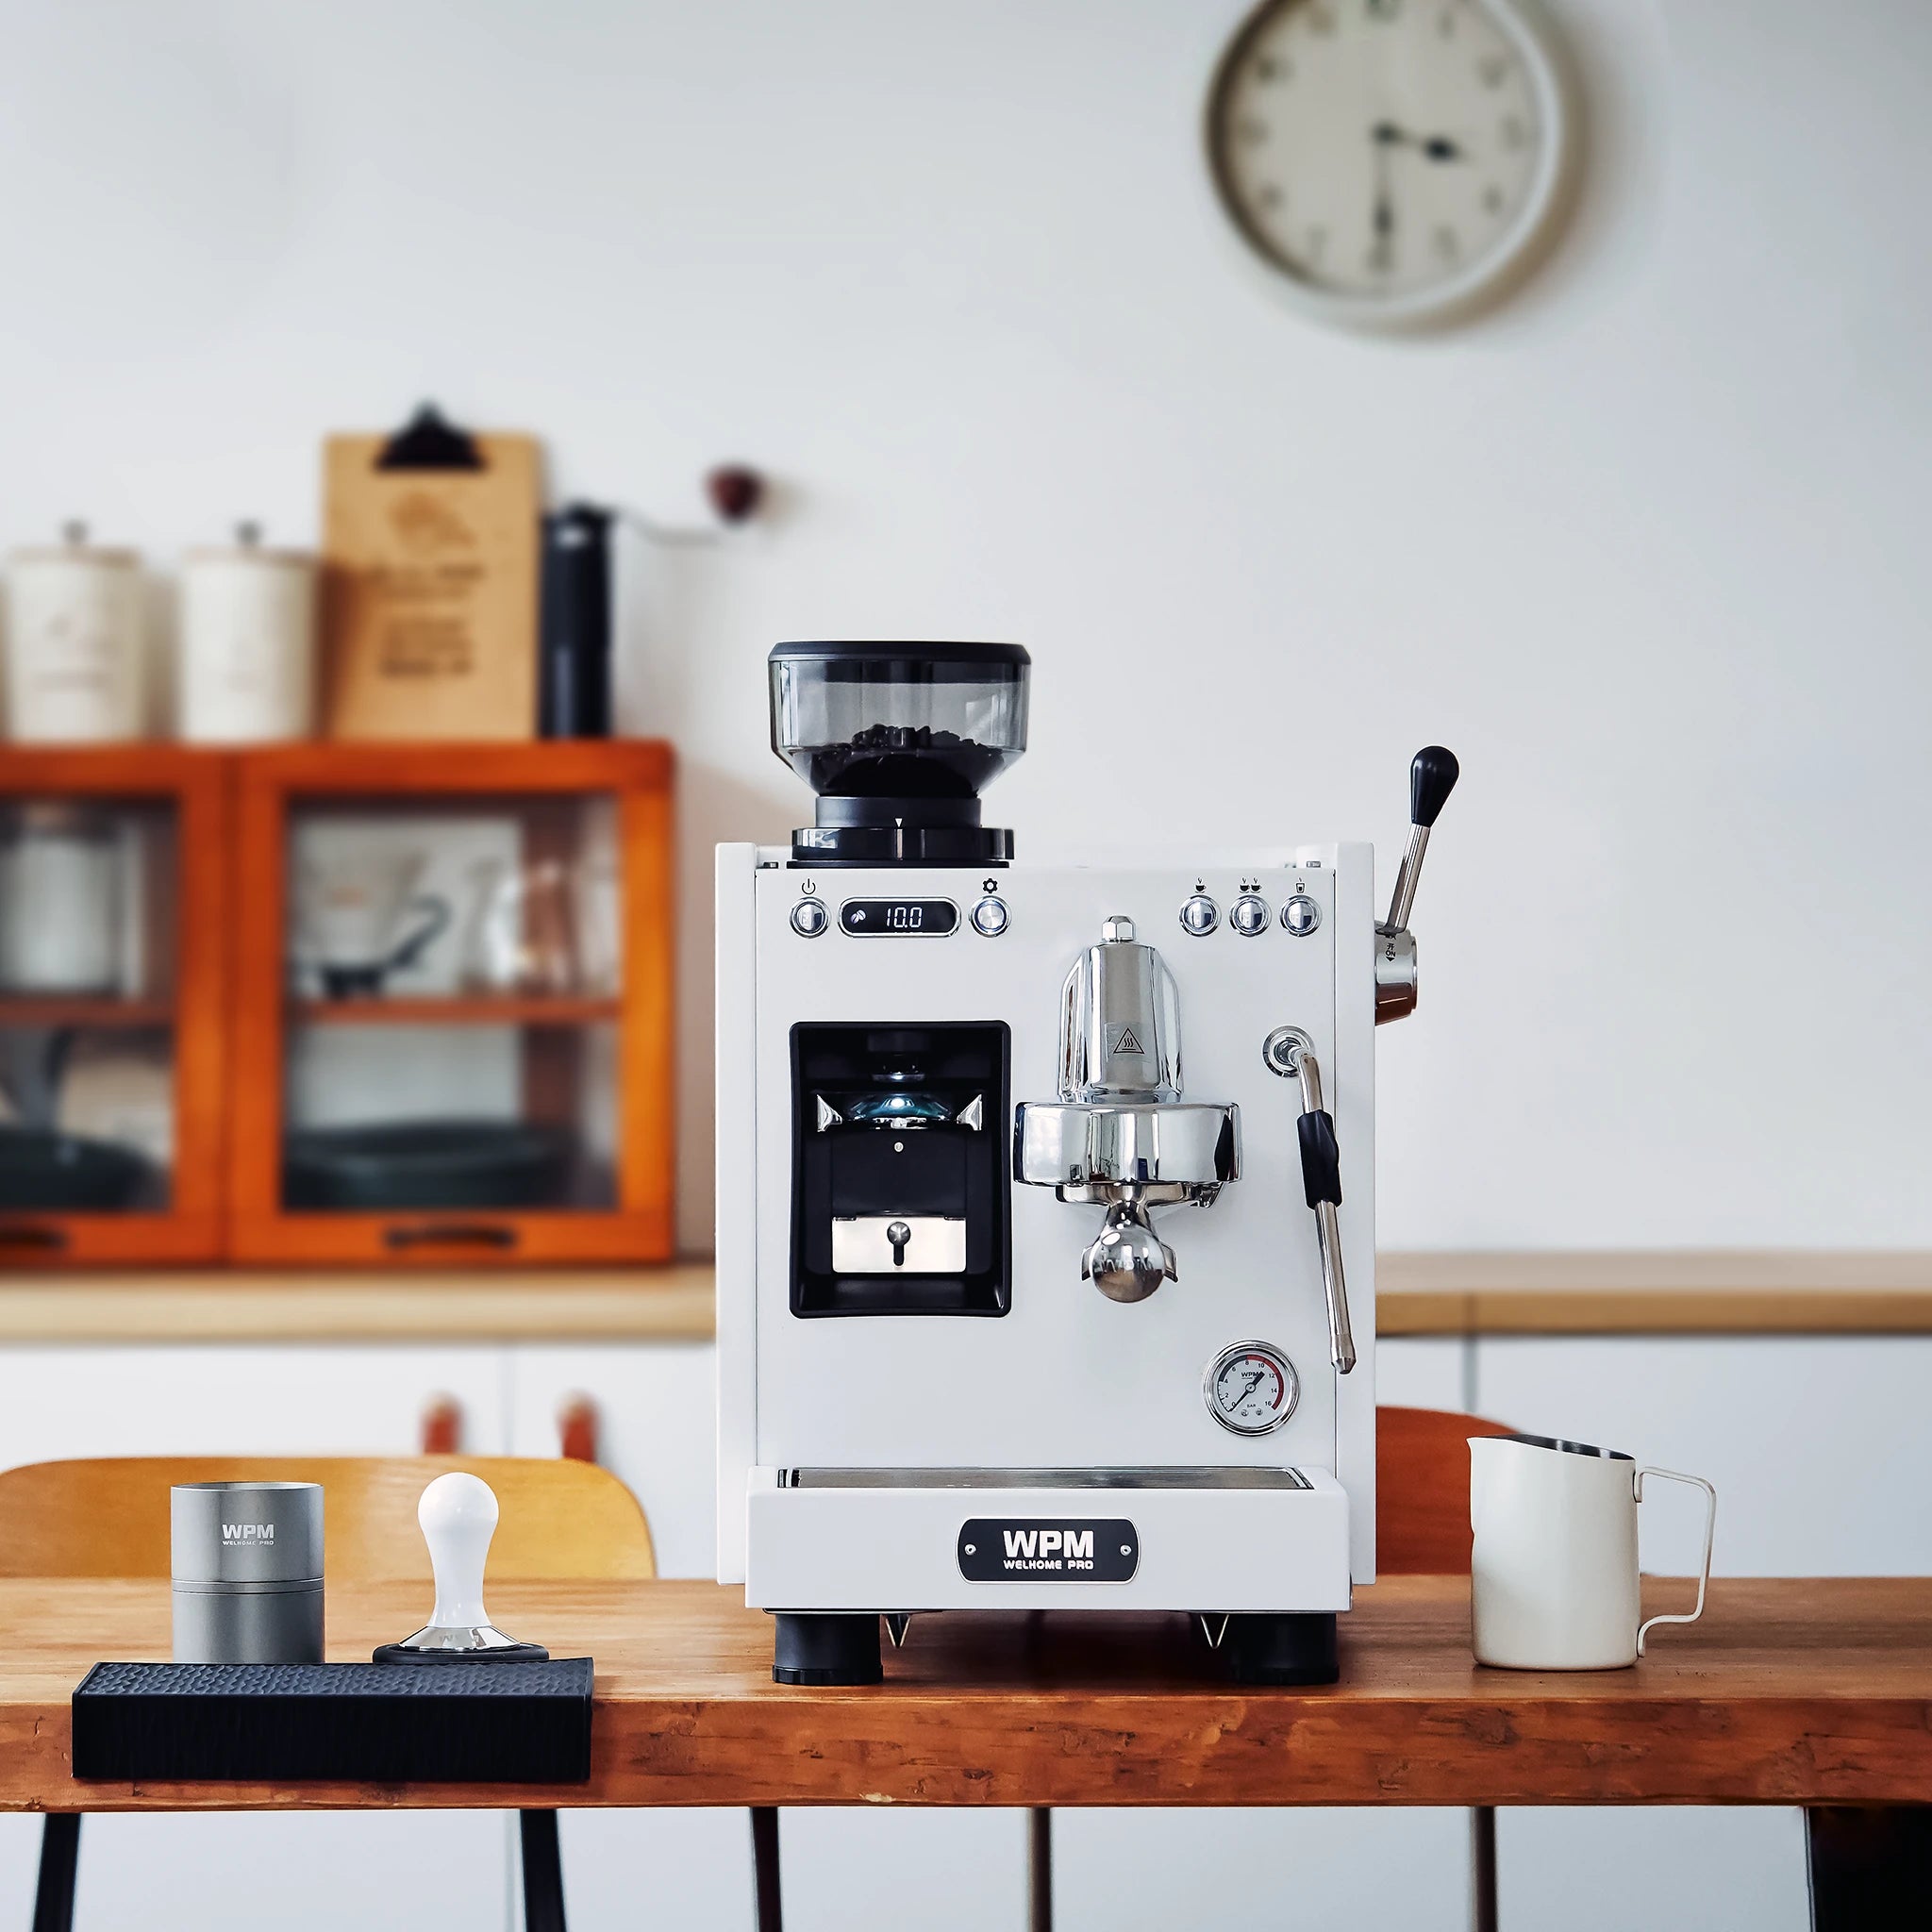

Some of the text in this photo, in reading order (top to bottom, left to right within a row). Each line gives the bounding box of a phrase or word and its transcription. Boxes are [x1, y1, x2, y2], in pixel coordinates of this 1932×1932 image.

[886, 907, 923, 928] 10.0
[222, 1524, 275, 1539] WPM
[1003, 1530, 1094, 1558] WPM
[1003, 1559, 1094, 1570] WELHOME PRO
